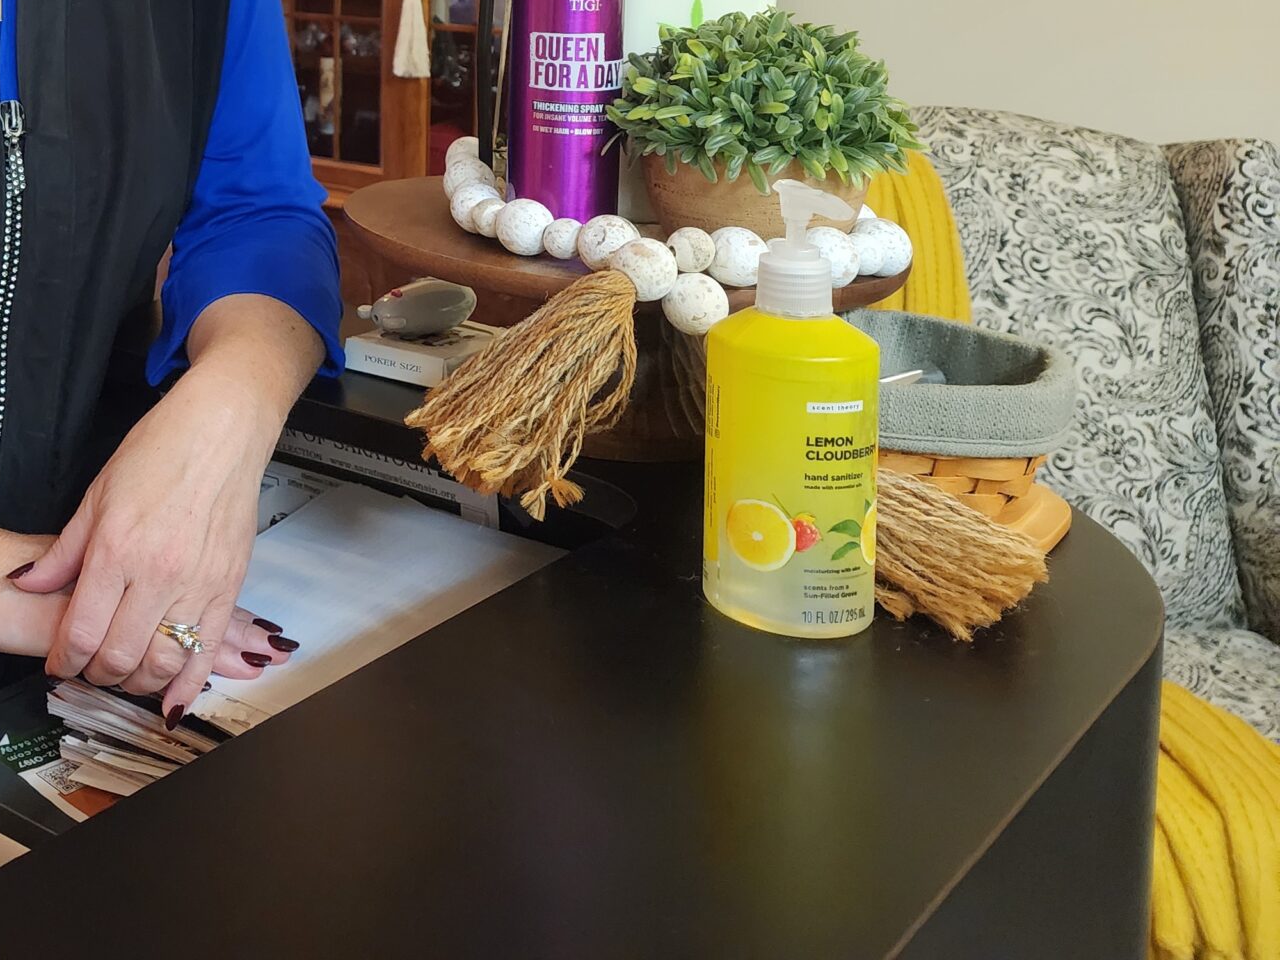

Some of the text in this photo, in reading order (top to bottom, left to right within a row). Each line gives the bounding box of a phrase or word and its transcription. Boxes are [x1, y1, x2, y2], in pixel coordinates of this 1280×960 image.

[535, 34, 600, 62] QUEEN
[534, 62, 621, 89] FOR A DAY
[532, 100, 604, 114] THICKENING SPRAY
[364, 353, 422, 374] POKER SIZE
[805, 436, 854, 448] LEMON
[804, 472, 864, 482] hand sanitizer
[802, 610, 813, 624] 10
[816, 610, 826, 624] FL
[18, 748, 59, 769] 12-0197
